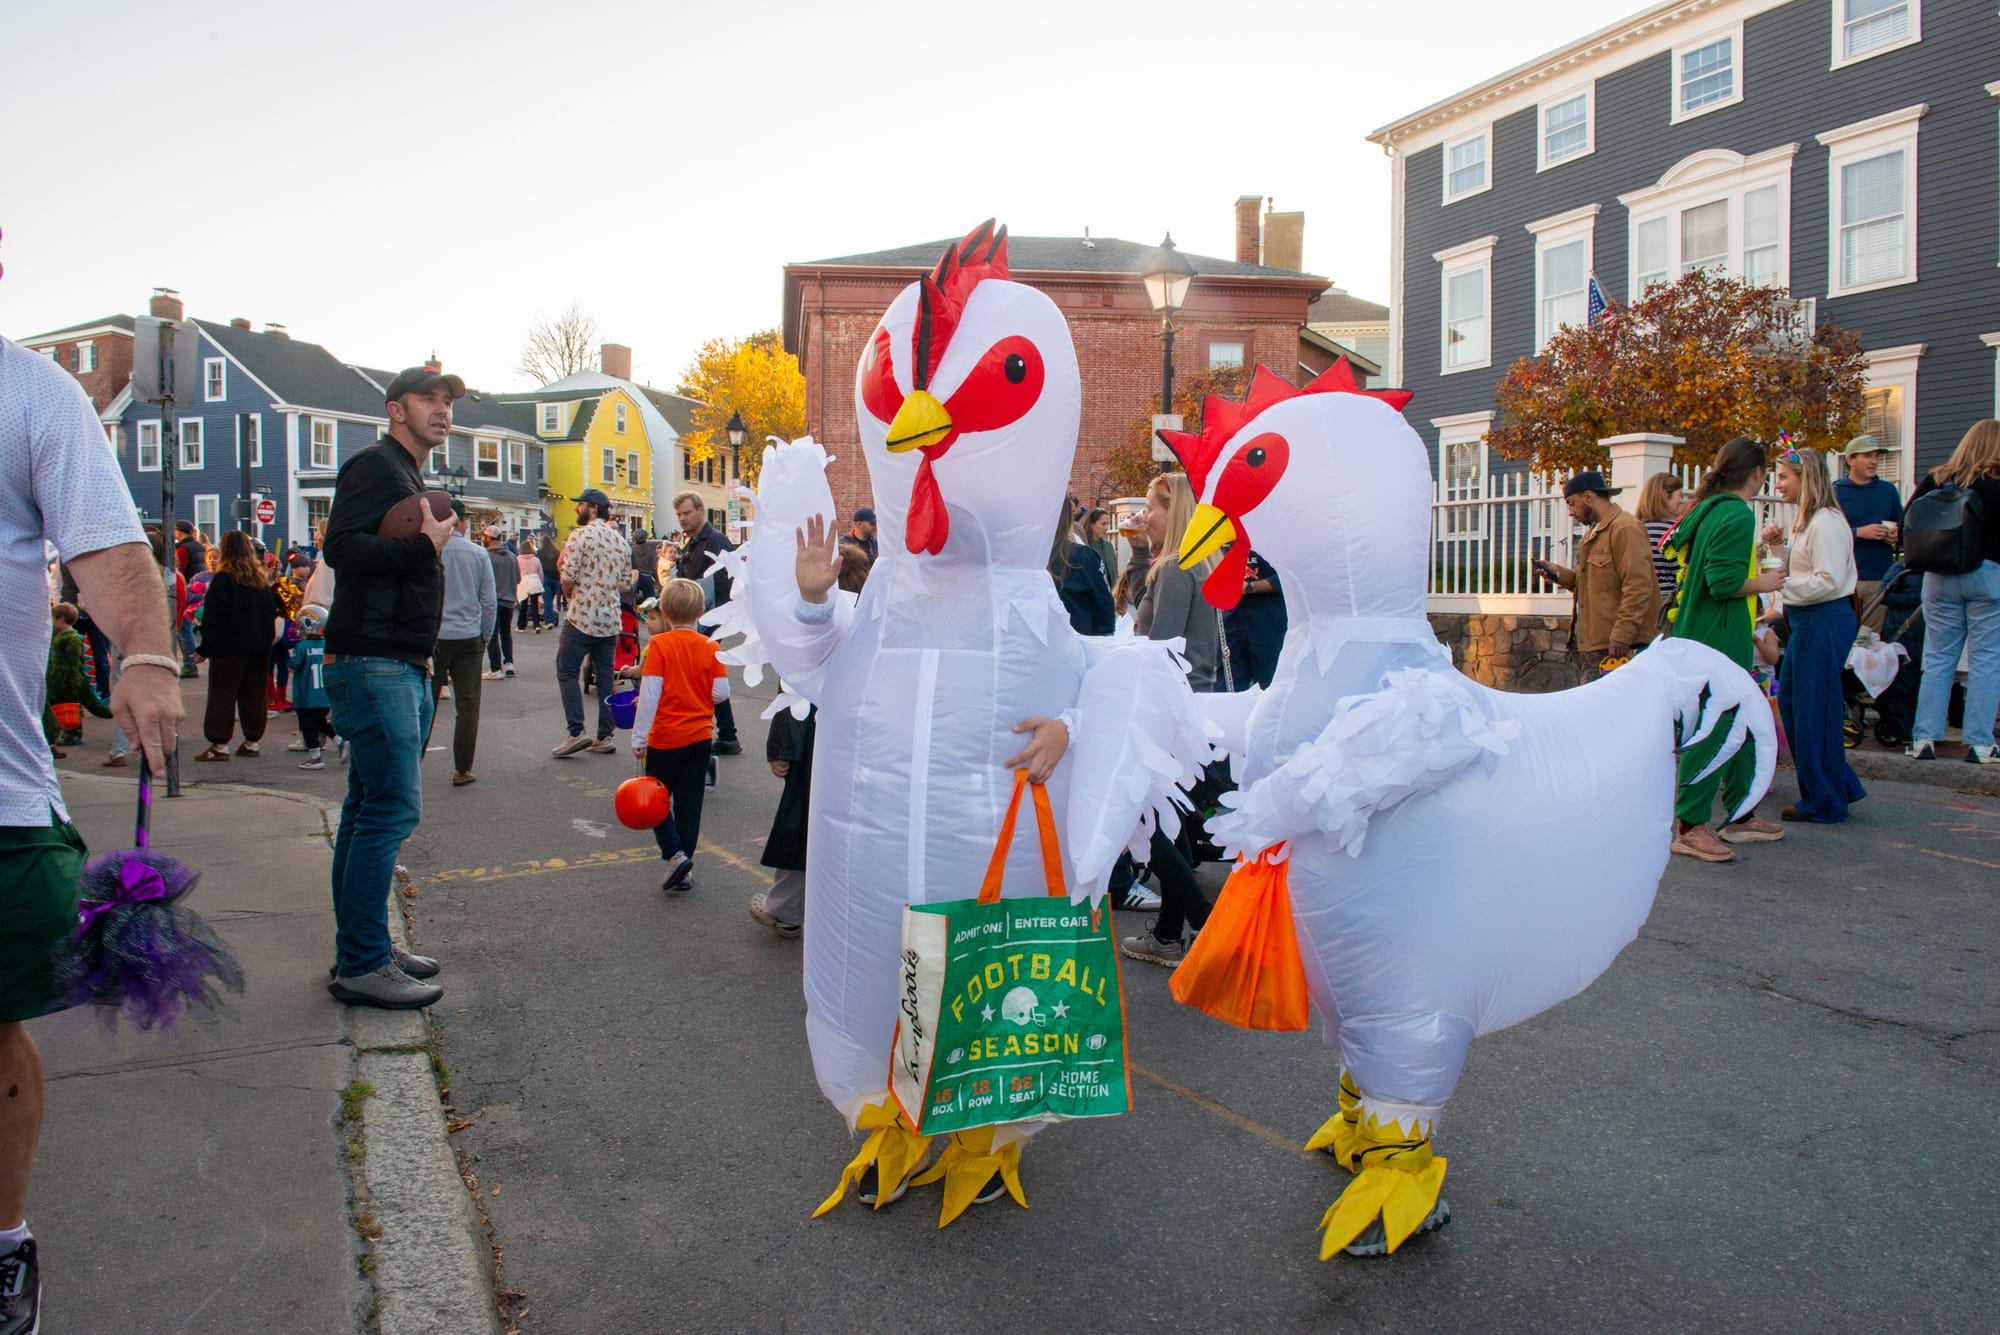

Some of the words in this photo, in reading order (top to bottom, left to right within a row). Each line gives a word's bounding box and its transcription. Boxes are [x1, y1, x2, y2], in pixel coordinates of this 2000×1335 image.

[1015, 917, 1056, 929] ENTER
[1060, 916, 1089, 928] GATE
[954, 926, 981, 944] ADMIT
[983, 922, 1003, 935] ONE
[951, 953, 1106, 1023] FOOTBALL
[968, 1033, 1079, 1061] SEASON
[1060, 1070, 1100, 1084] HOME
[1009, 1090, 1036, 1104] SEAT
[1048, 1084, 1110, 1099] SECTION
[932, 1103, 954, 1116] BOX
[968, 1096, 994, 1109] ROW
